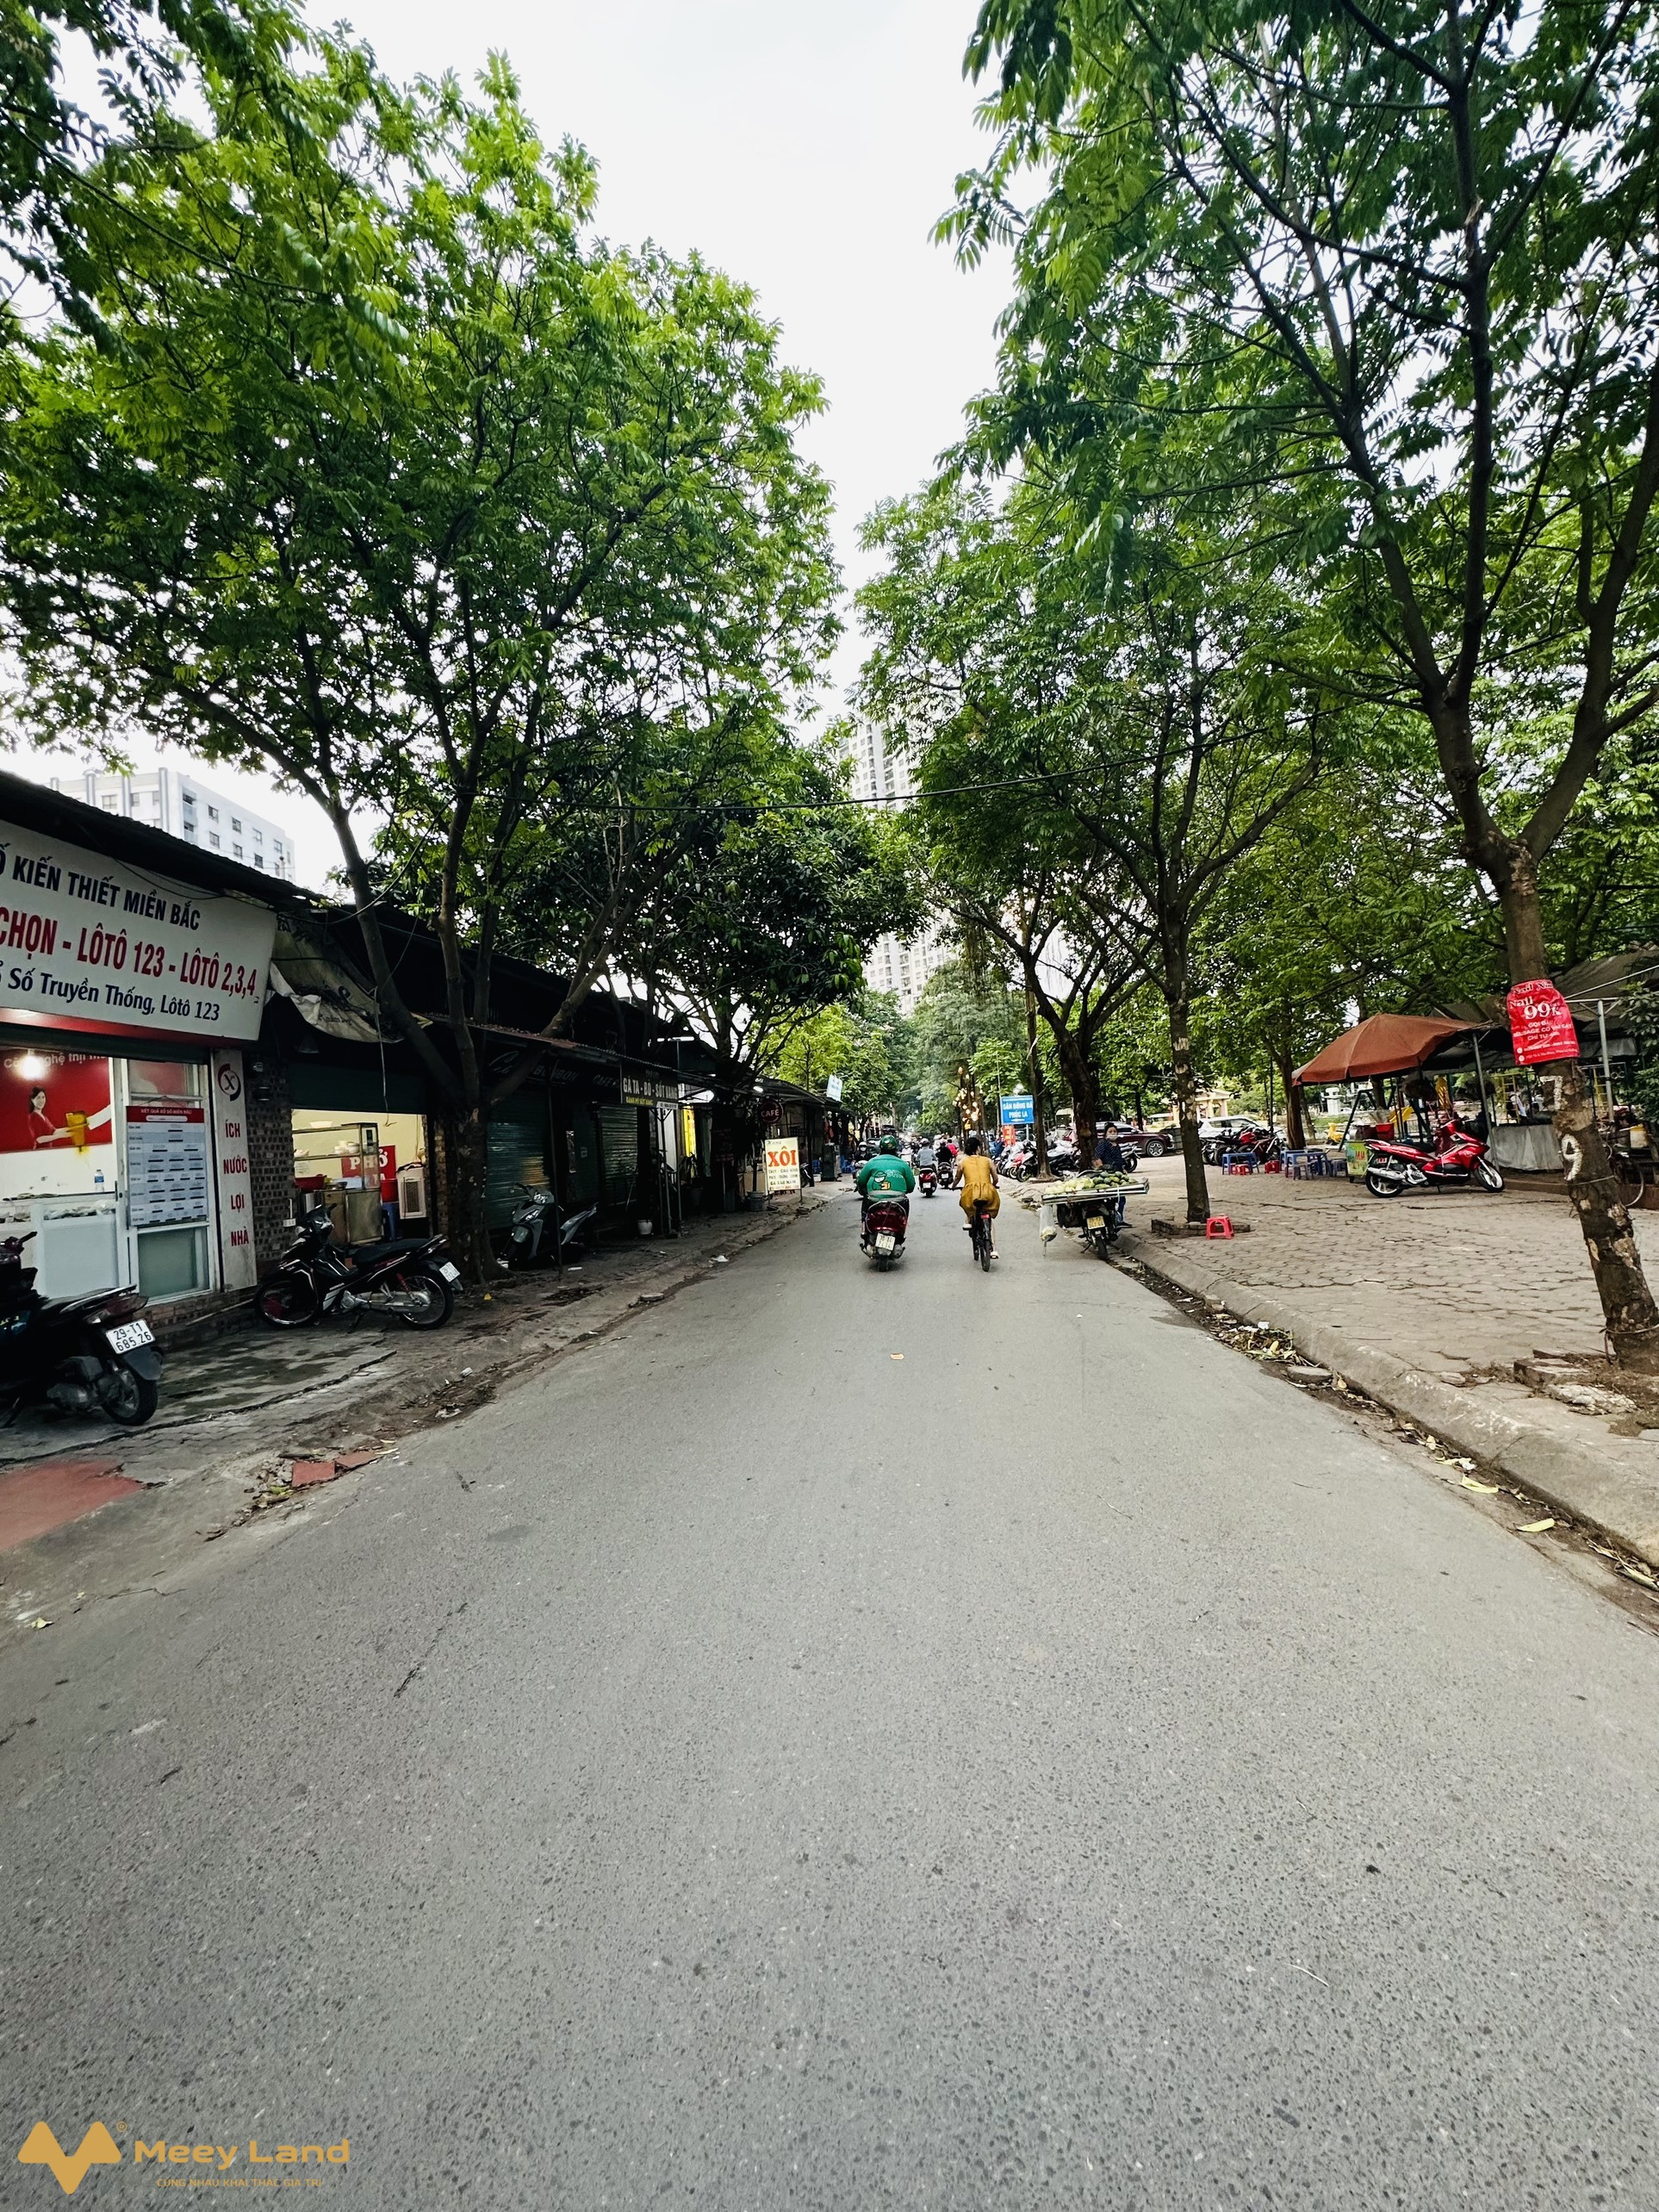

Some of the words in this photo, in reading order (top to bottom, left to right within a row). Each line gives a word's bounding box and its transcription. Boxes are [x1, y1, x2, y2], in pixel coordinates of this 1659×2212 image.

[13, 855, 61, 892] KIẾN
[68, 872, 121, 907] THIẾT
[123, 889, 167, 922] MIỀN
[170, 900, 201, 930] BẮC
[78, 923, 127, 970] LÔTÔ
[134, 941, 165, 978] 123
[180, 948, 219, 988] LÔTÔ
[221, 963, 257, 999] 2,3,4
[8, 967, 35, 991] Số
[40, 972, 99, 1003] Truyền
[106, 985, 156, 1016] Thống,
[160, 995, 190, 1017] Lôtô
[195, 1001, 221, 1021] 123
[1510, 996, 1534, 1010] Nail
[623, 1075, 632, 1094] GÀ
[632, 1079, 640, 1095] TA
[655, 1080, 665, 1098] SỐT
[226, 1119, 241, 1138] ÍCH
[223, 1154, 248, 1175] NƯỚC
[349, 1148, 388, 1170] PHỞ
[767, 1146, 798, 1167] XÔI
[230, 1193, 245, 1213] LỢI
[230, 1226, 250, 1246] NHÀ
[114, 1323, 144, 1340] 29-T1
[115, 1331, 152, 1351] 685.26
